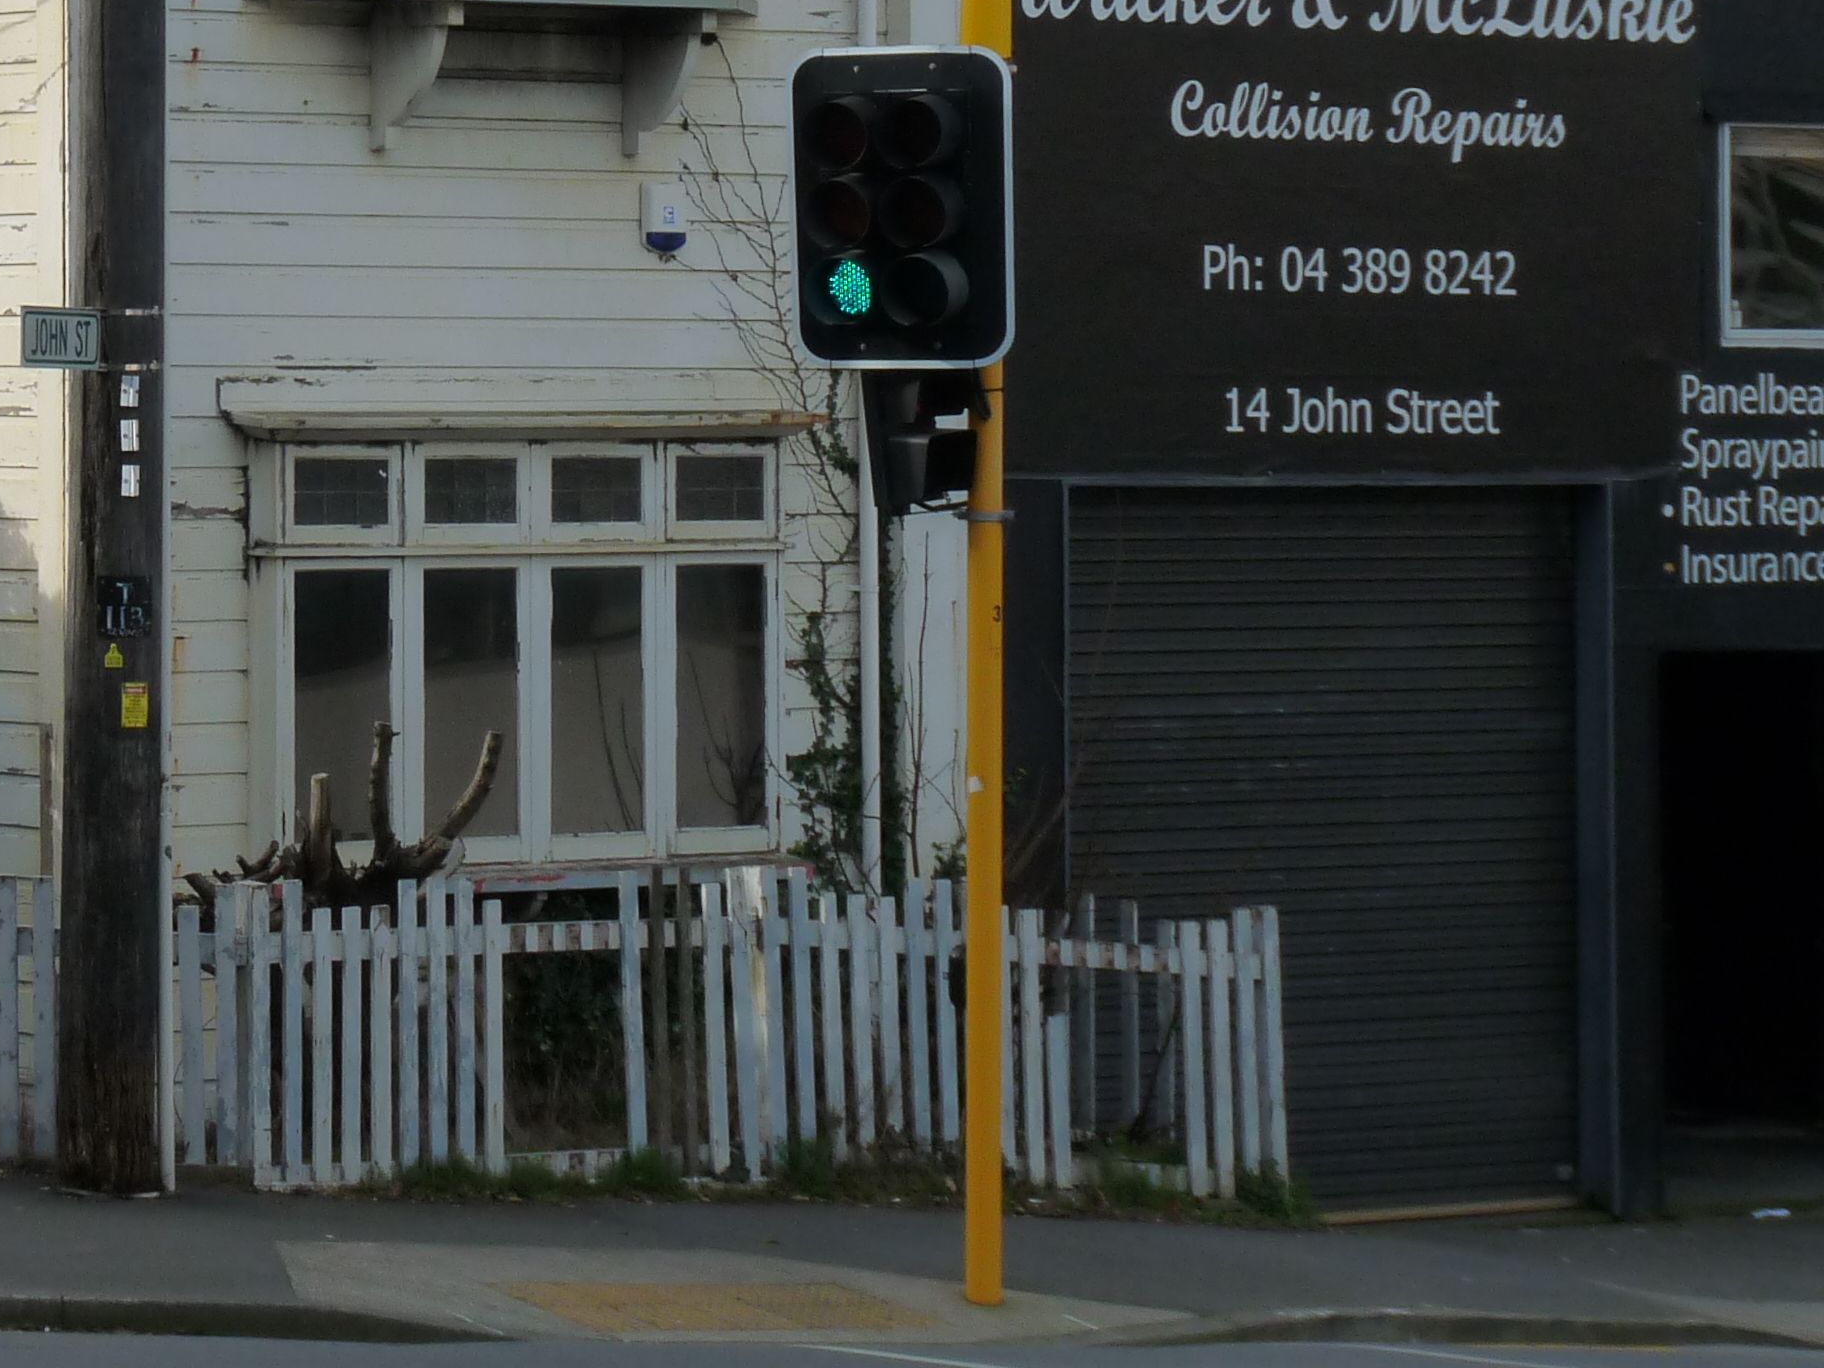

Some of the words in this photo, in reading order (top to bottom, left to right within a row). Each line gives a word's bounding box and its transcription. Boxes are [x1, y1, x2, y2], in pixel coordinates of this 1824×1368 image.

[1171, 80, 1374, 143] Collision
[1386, 87, 1566, 164] Repairs
[1203, 244, 1263, 291] Ph:
[1280, 246, 1328, 293] 04
[1342, 248, 1411, 295] 389
[1425, 249, 1517, 296] 8242
[31, 318, 69, 356] JOHN
[75, 320, 92, 358] ST
[1225, 388, 1271, 433] 14
[1282, 387, 1373, 434] John
[1387, 389, 1501, 435] Street
[1680, 428, 1824, 479] Spraypai
[1681, 486, 1752, 527] Rust
